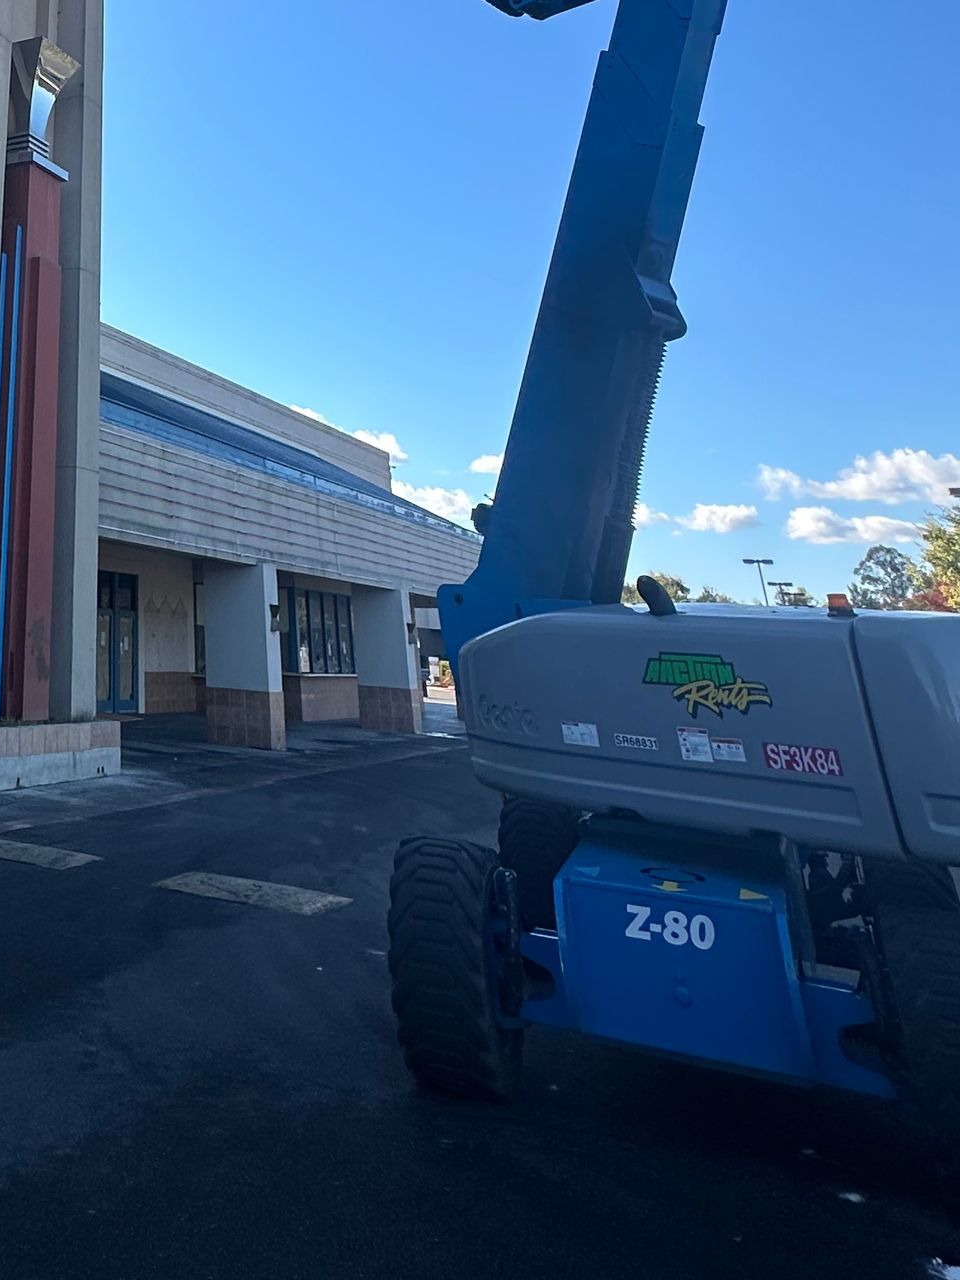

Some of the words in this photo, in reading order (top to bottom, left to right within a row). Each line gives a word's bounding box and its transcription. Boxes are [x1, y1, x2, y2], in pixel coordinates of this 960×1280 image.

[672, 676, 772, 719] Rents
[766, 743, 840, 776] SF3K84
[625, 904, 715, 950] Z-80
